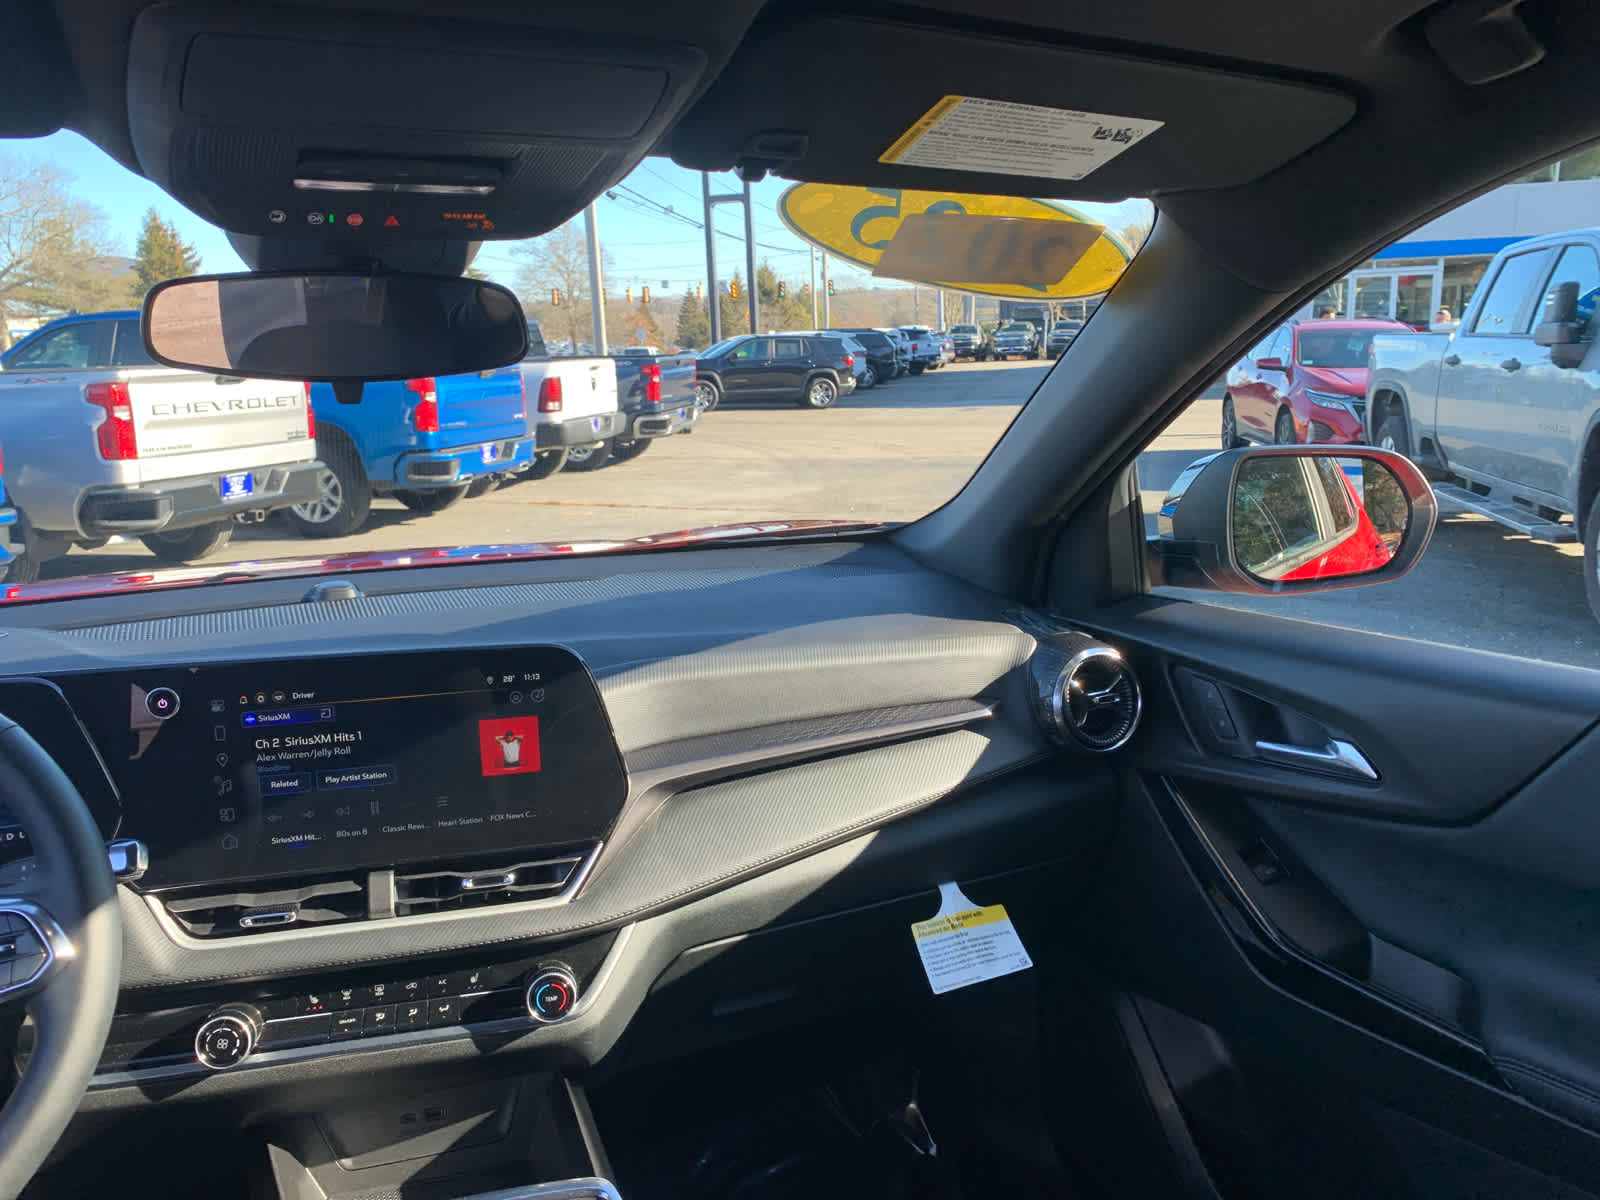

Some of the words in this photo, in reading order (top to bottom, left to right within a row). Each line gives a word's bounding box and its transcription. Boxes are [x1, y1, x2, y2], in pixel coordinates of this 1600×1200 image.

[151, 395, 298, 416] CHEVROLET
[524, 672, 541, 681] 11:13
[292, 691, 315, 700] Driver
[258, 712, 291, 722] SiriusXM
[255, 738, 270, 749] Ch
[272, 738, 280, 748] 2
[284, 733, 332, 747] SiriusXM
[334, 731, 356, 743] Hits
[356, 730, 362, 740] 1
[256, 753, 276, 762] Alex
[334, 745, 351, 756] Roll
[325, 774, 341, 784] Play
[341, 772, 361, 782] Artist
[362, 770, 388, 780] Station
[270, 778, 299, 788] Related
[438, 819, 458, 828] Heart
[459, 816, 483, 826] Station
[490, 814, 504, 822] FOX
[382, 825, 407, 834] Classic
[271, 834, 302, 845] SiriusXM
